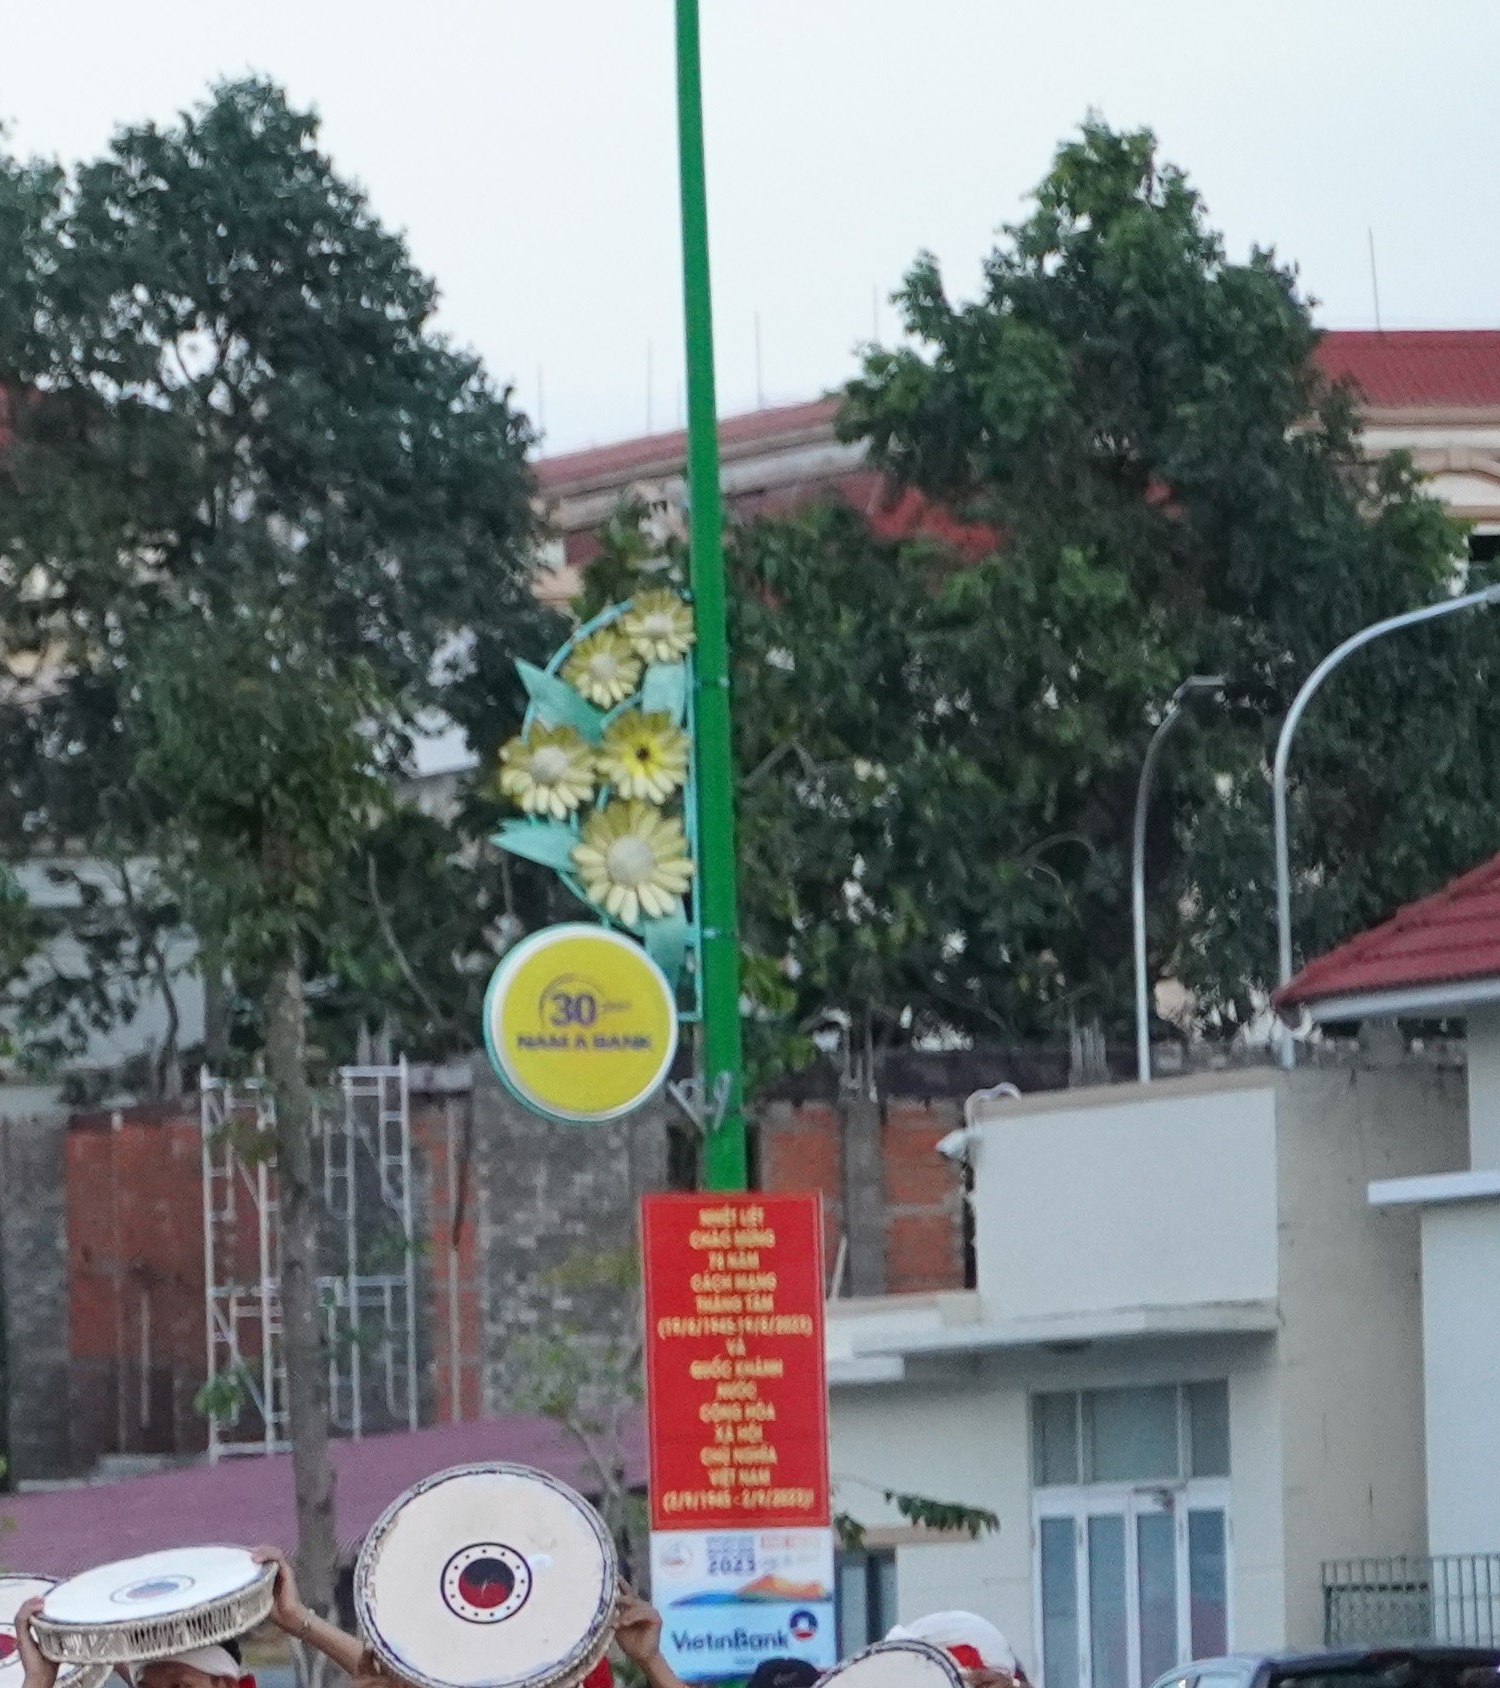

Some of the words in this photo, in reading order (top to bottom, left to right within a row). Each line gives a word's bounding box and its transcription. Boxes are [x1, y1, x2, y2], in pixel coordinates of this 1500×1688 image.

[552, 992, 596, 1027] 30
[517, 1034, 568, 1048] NAM
[593, 1034, 650, 1048] BANK
[690, 1269, 733, 1293] CÁCH
[696, 1293, 743, 1314] THÁNG
[745, 1293, 774, 1313] TÁM
[738, 1465, 771, 1487] NAM
[672, 1628, 790, 1652] VietinBank
